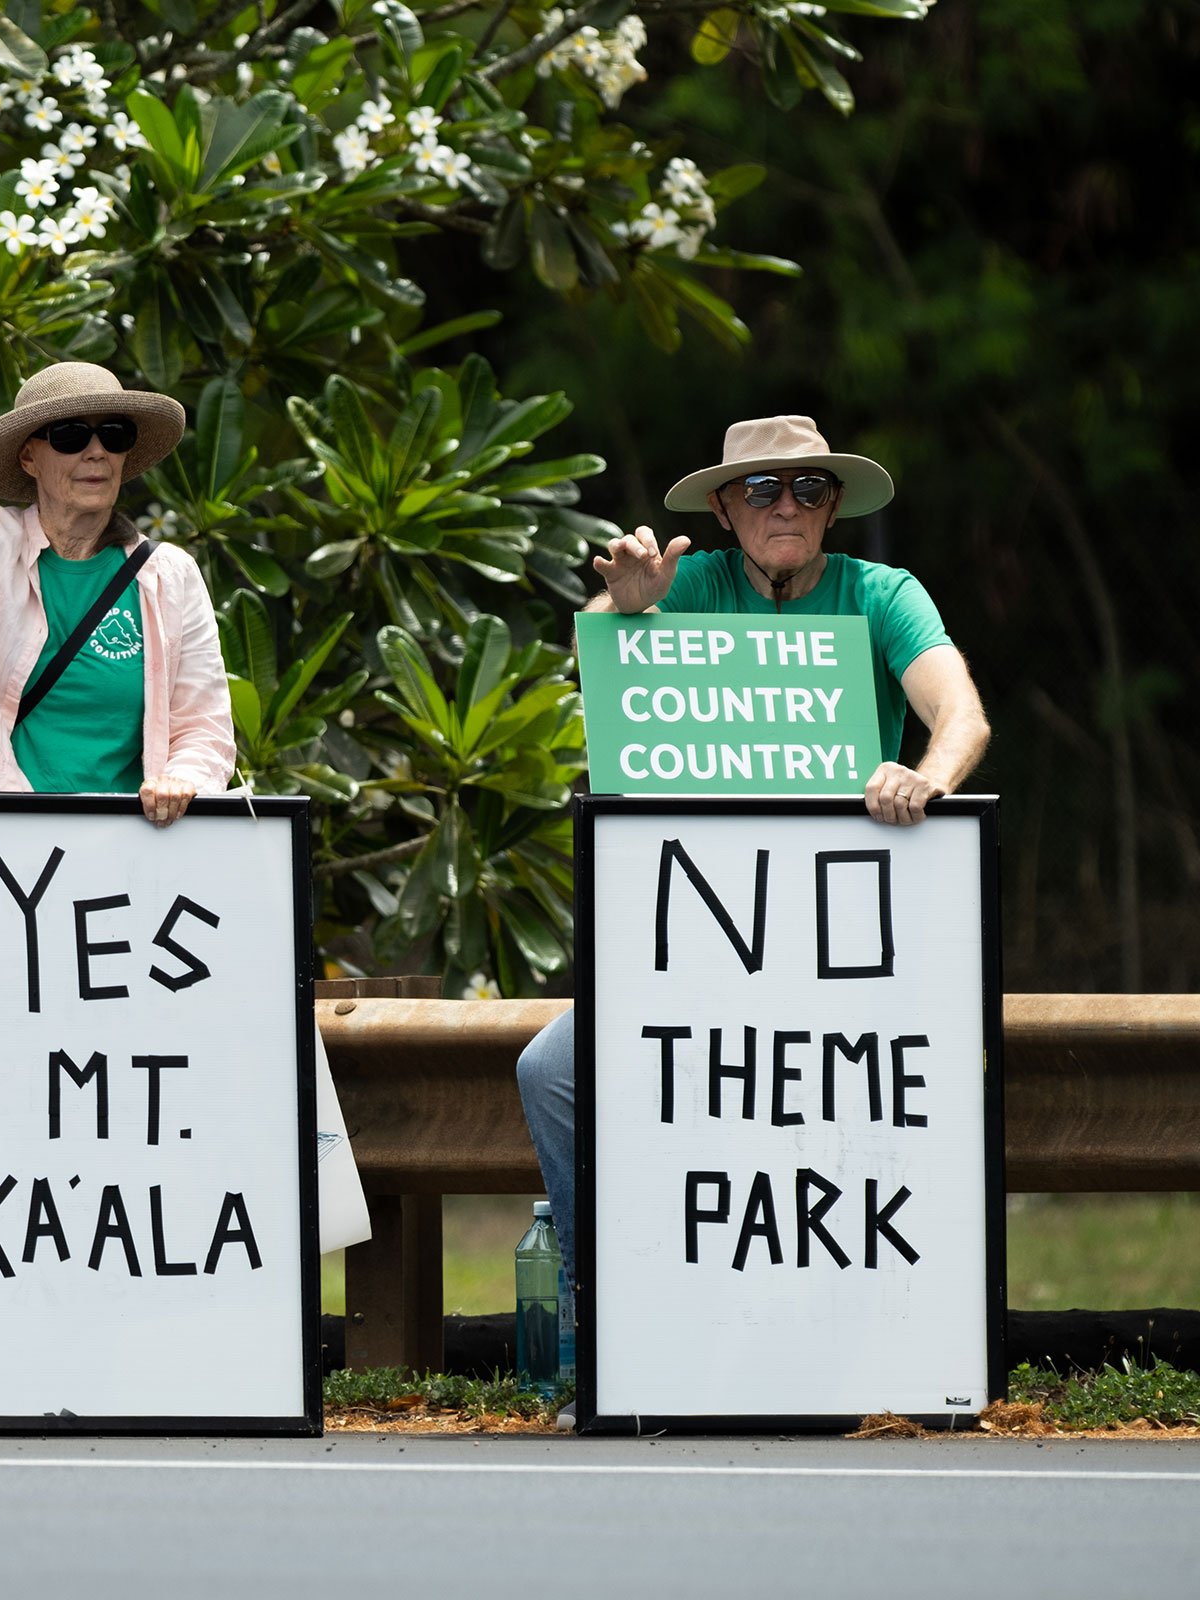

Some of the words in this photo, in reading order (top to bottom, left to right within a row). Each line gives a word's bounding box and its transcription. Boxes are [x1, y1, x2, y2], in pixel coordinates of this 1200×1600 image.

[90, 639, 142, 660] COALITION
[617, 629, 736, 666] KEEP
[746, 630, 839, 667] THE
[620, 685, 844, 724] COUNTRY
[618, 743, 859, 781] COUNTRY!
[654, 838, 896, 980] NO
[48, 1048, 192, 1146] MT.
[641, 1025, 931, 1128] THEME
[684, 1167, 921, 1272] PARK
